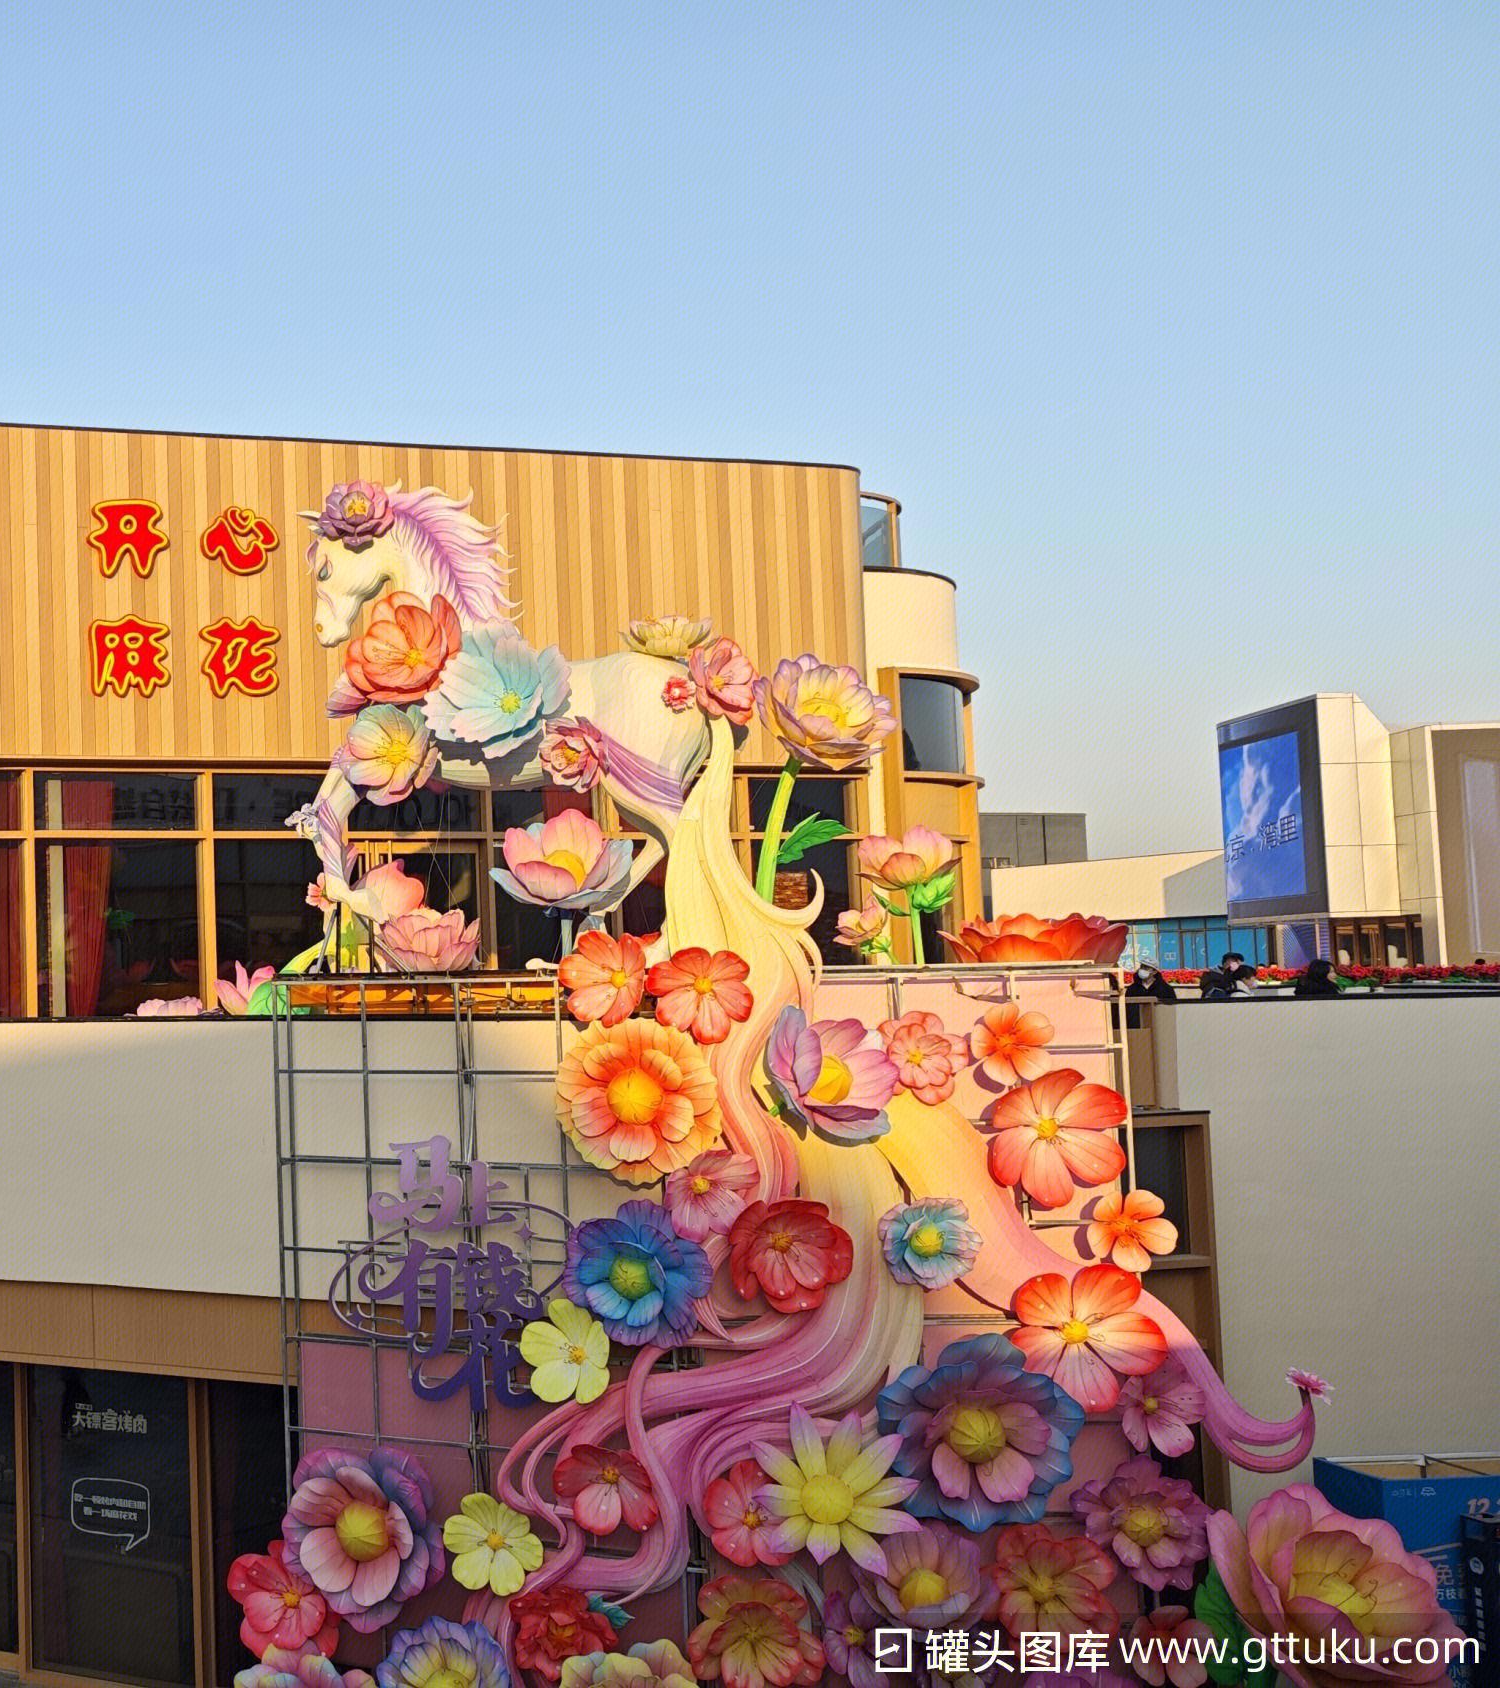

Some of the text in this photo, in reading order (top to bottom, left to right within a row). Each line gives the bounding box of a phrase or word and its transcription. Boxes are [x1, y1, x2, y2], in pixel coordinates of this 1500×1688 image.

[87, 498, 280, 579] 开心
[89, 613, 282, 699] 麻花
[72, 1408, 148, 1434] 大镖客烤肉
